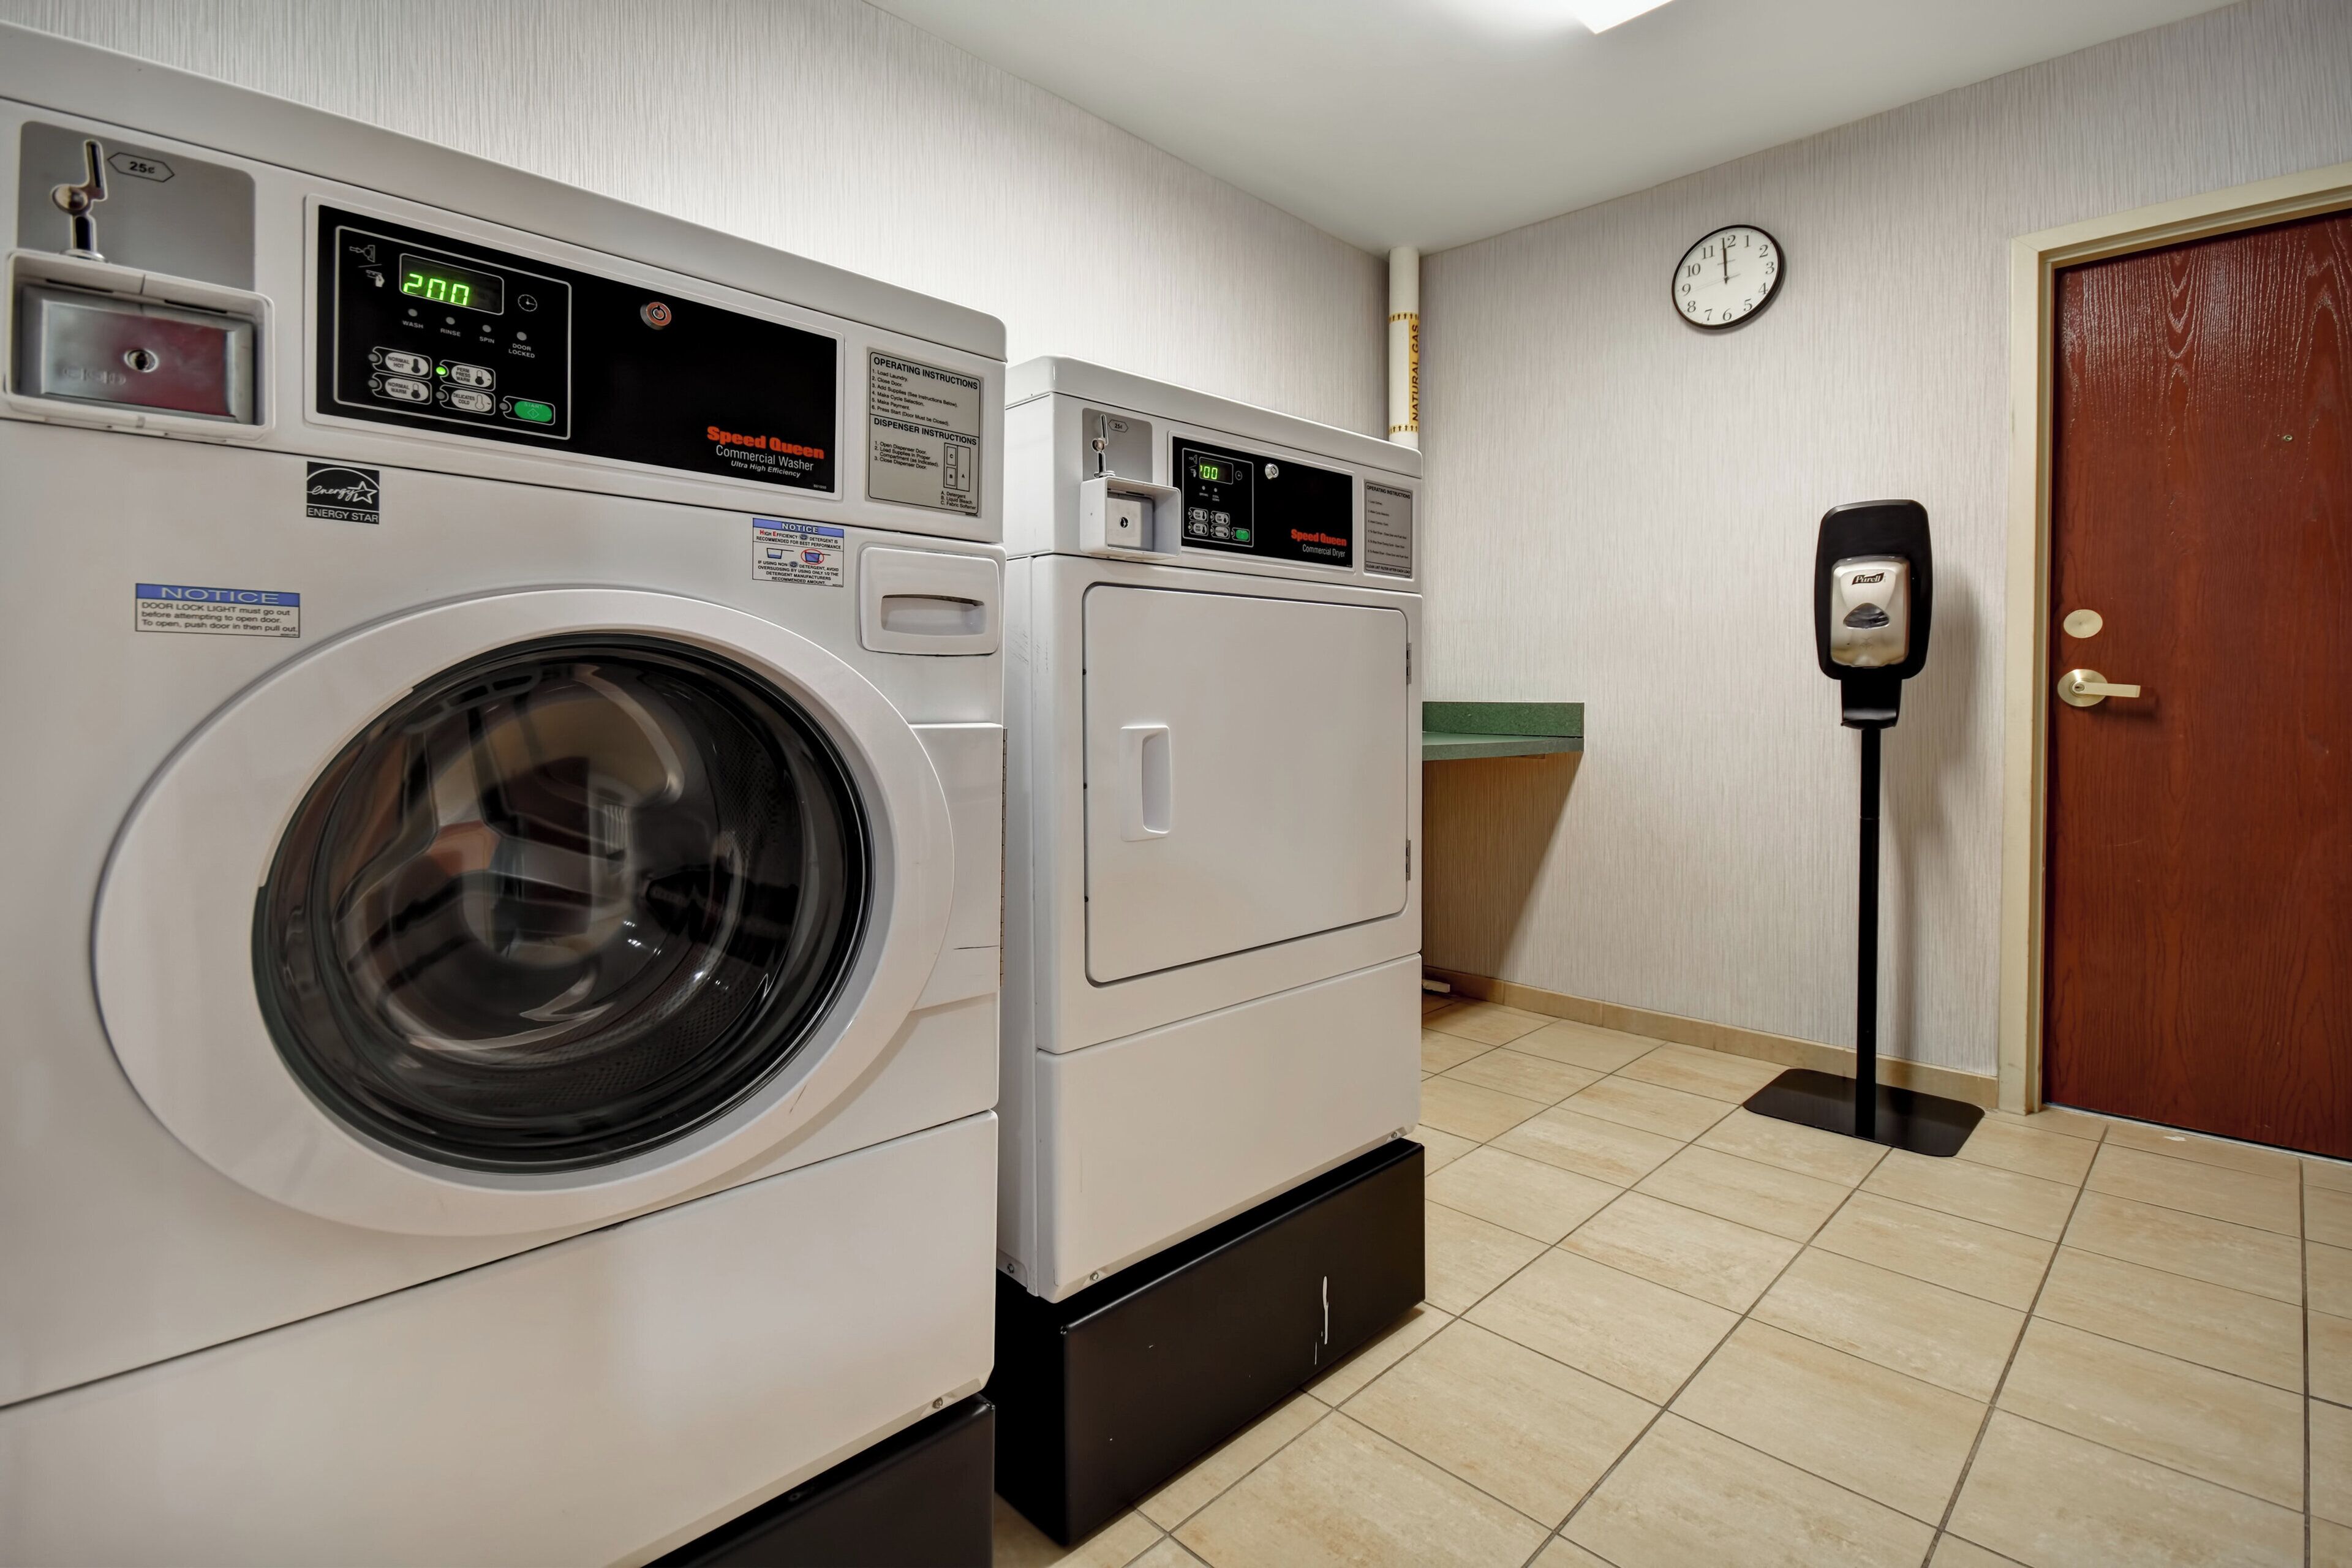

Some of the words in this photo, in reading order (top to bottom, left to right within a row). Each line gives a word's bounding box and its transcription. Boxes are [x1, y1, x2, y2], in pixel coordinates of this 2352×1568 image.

[129, 161, 155, 173] 25¢
[1744, 235, 1751, 247] 1
[1702, 246, 1714, 260] 11
[1759, 244, 1768, 258] 2
[1687, 263, 1701, 277] 10
[1765, 262, 1774, 274] 3
[404, 273, 469, 306] 200
[1682, 284, 1691, 296] 9
[1758, 282, 1768, 295] 4
[1687, 301, 1696, 312] 8
[1744, 298, 1752, 311] 5
[1705, 308, 1713, 321] 7
[1723, 307, 1732, 321] 6
[402, 320, 424, 328] WASH
[440, 328, 461, 336] RINSE
[508, 349, 535, 358] LOCKED
[874, 357, 920, 375] OPERATING
[923, 369, 978, 390] INSTRUCTIONS
[890, 373, 908, 382] Laundry.
[904, 398, 924, 406] Selection.
[875, 418, 919, 434] DISPENSER
[922, 428, 976, 445] INSTRUCTIONS
[707, 426, 766, 449] Speed
[769, 437, 824, 459] Queen
[716, 445, 775, 464] Commercial
[778, 456, 813, 471] Washer
[767, 466, 801, 478] Efficiency
[1387, 490, 1410, 499] INSTRUCTIONS
[307, 508, 349, 519] ENERGY
[352, 513, 378, 522] STAR
[782, 523, 818, 533] NOTICE
[1291, 529, 1319, 542] Speed
[1321, 533, 1347, 546] Queen
[1302, 544, 1331, 556] Commercial
[1332, 549, 1345, 558] Dryer
[162, 587, 279, 604] NOTICE
[174, 613, 222, 622] attempting
